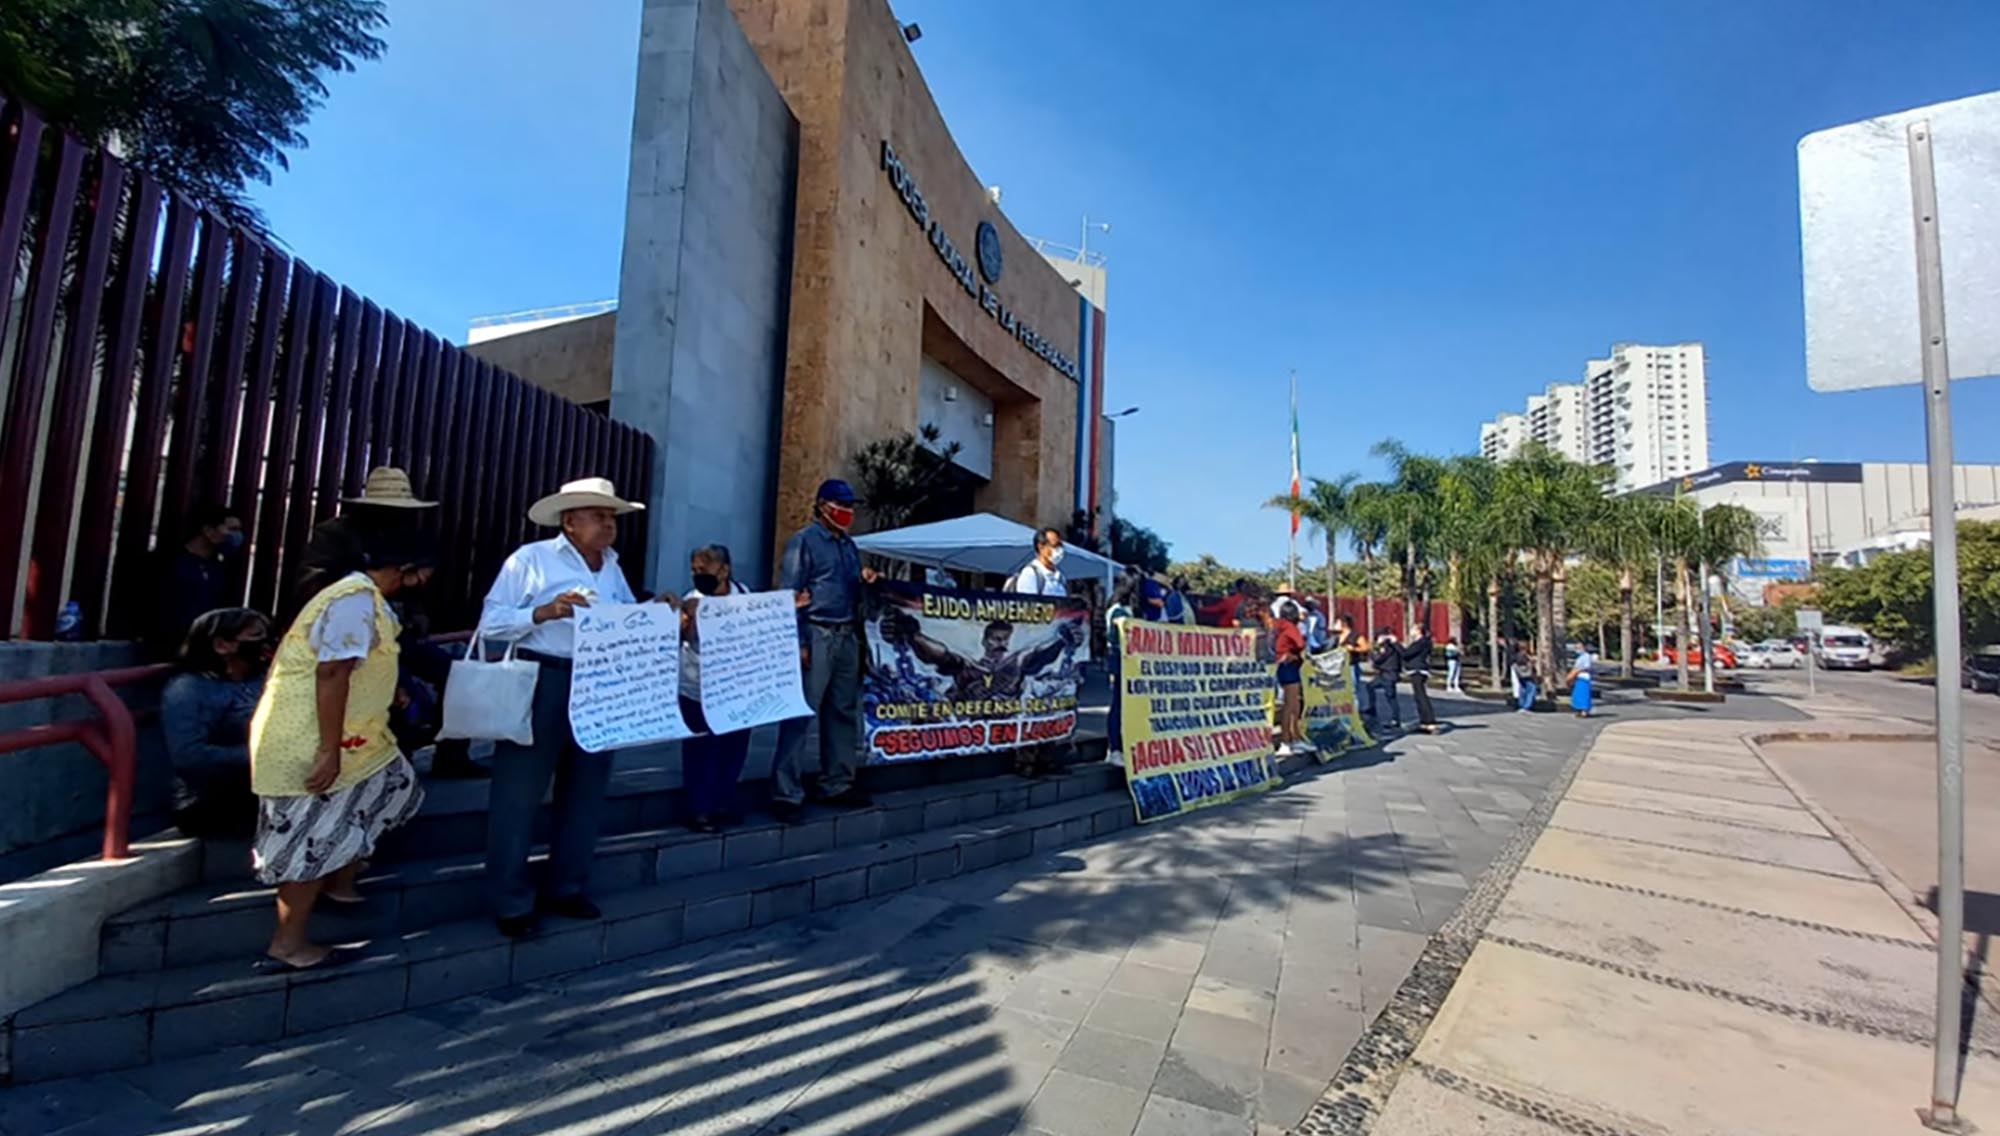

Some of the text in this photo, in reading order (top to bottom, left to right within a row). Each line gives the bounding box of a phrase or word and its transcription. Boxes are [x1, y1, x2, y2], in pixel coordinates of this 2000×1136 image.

[880, 140, 929, 231] PODER
[928, 221, 976, 299] JUDICIAL
[978, 284, 998, 318] DE
[998, 304, 1016, 335] LA
[923, 593, 971, 617] EJIDO
[1141, 660, 1151, 675] EL
[1153, 660, 1200, 675] DESPOJO
[1202, 662, 1223, 675] DEL
[983, 674, 993, 688] Y
[1127, 679, 1149, 694] LOS
[1150, 680, 1197, 694] PUEBLOS
[1199, 680, 1206, 692] Y
[933, 702, 952, 717] EN
[955, 700, 1021, 716] DEFENSA
[991, 721, 1018, 743] EN
[1131, 737, 1186, 775] ¡AGUA
